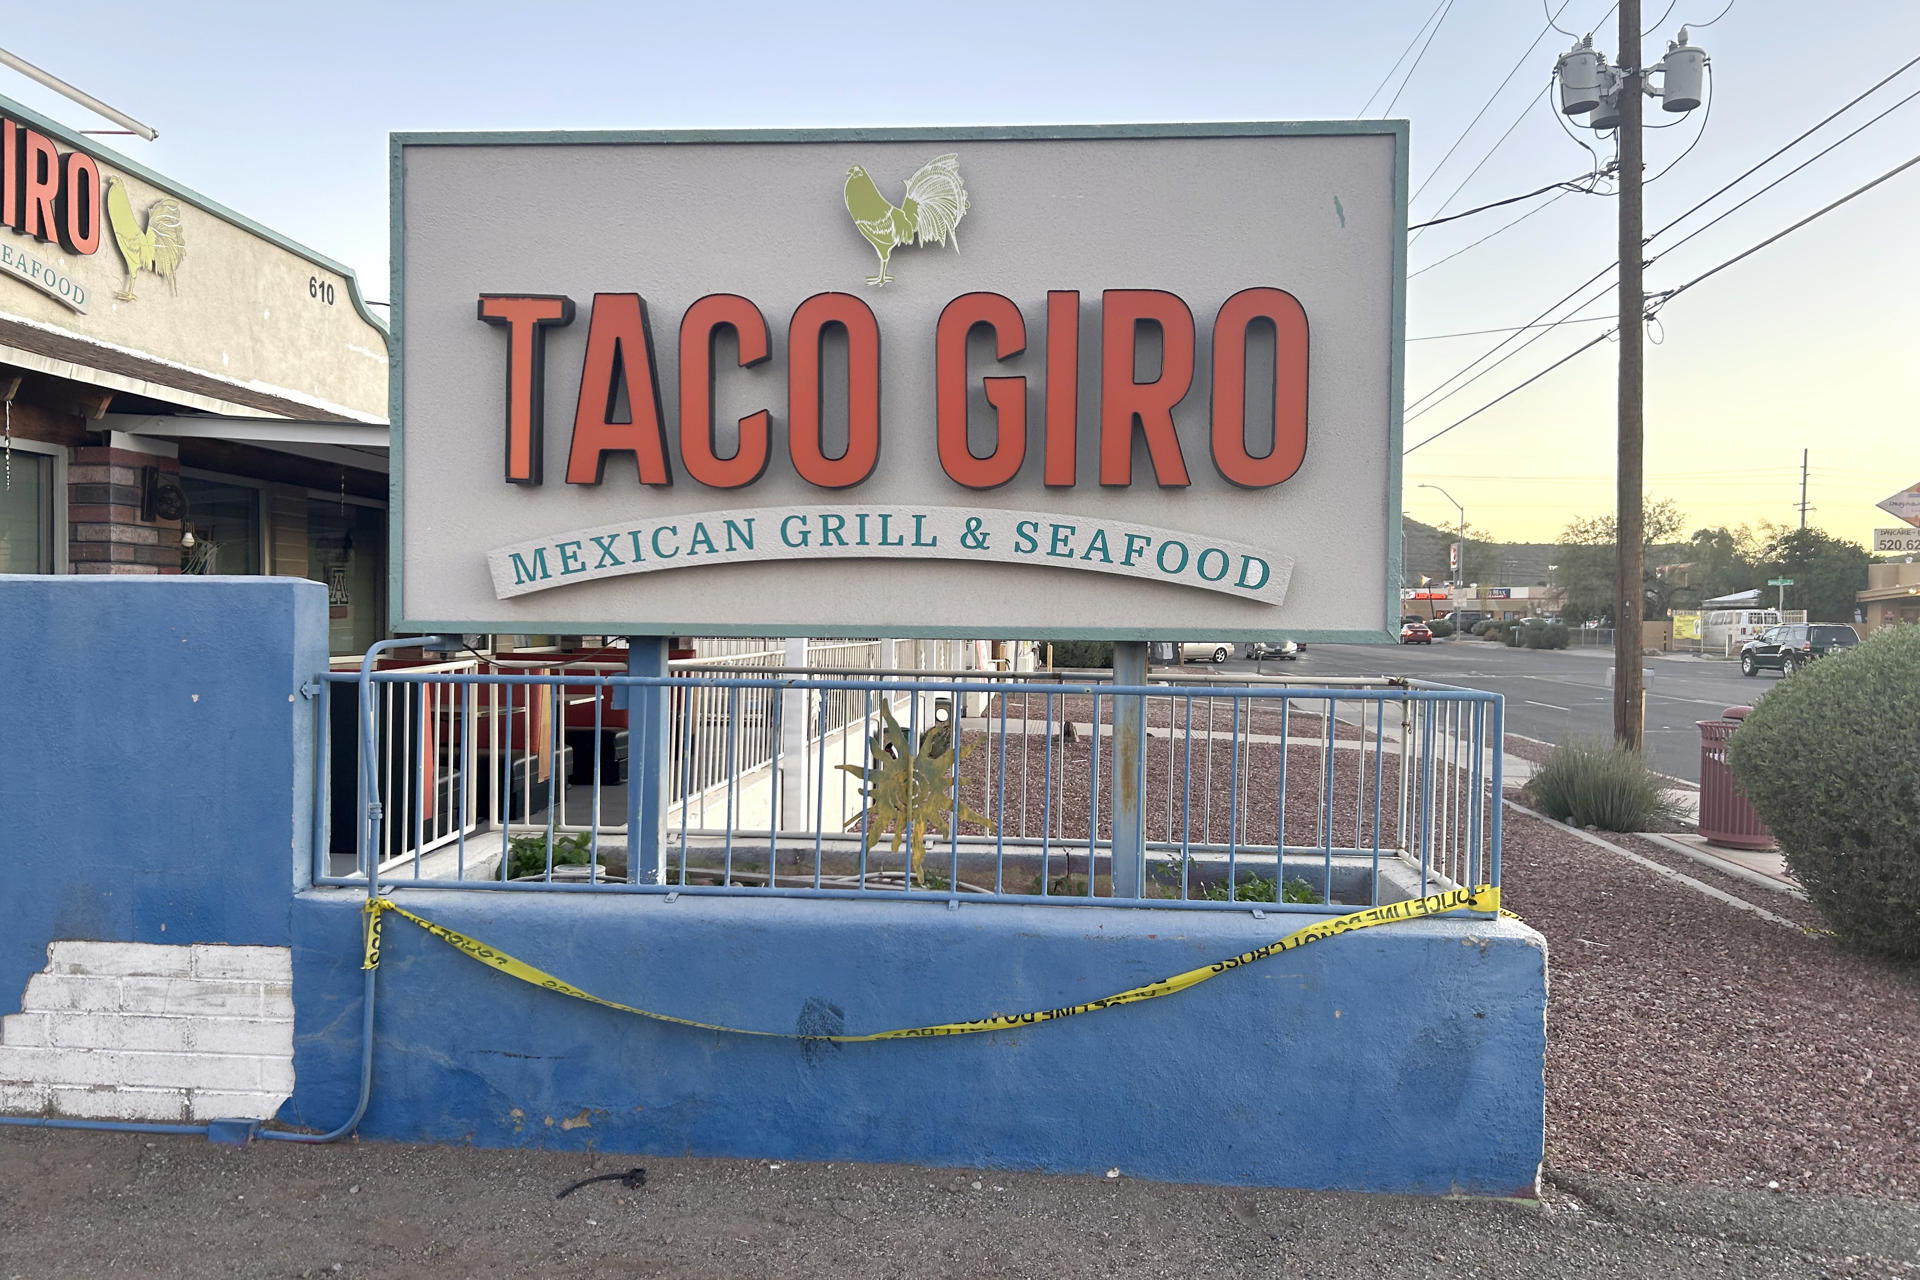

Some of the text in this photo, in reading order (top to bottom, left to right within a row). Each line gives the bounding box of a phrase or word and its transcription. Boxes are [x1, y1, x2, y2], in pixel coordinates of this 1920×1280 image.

[1, 117, 100, 255] IRO
[1, 244, 85, 305] EAFOOD
[310, 276, 334, 305] 610
[478, 287, 1310, 488] TACO GIRO
[508, 513, 1271, 591] MEXICAN GRILL & SEAFOOD
